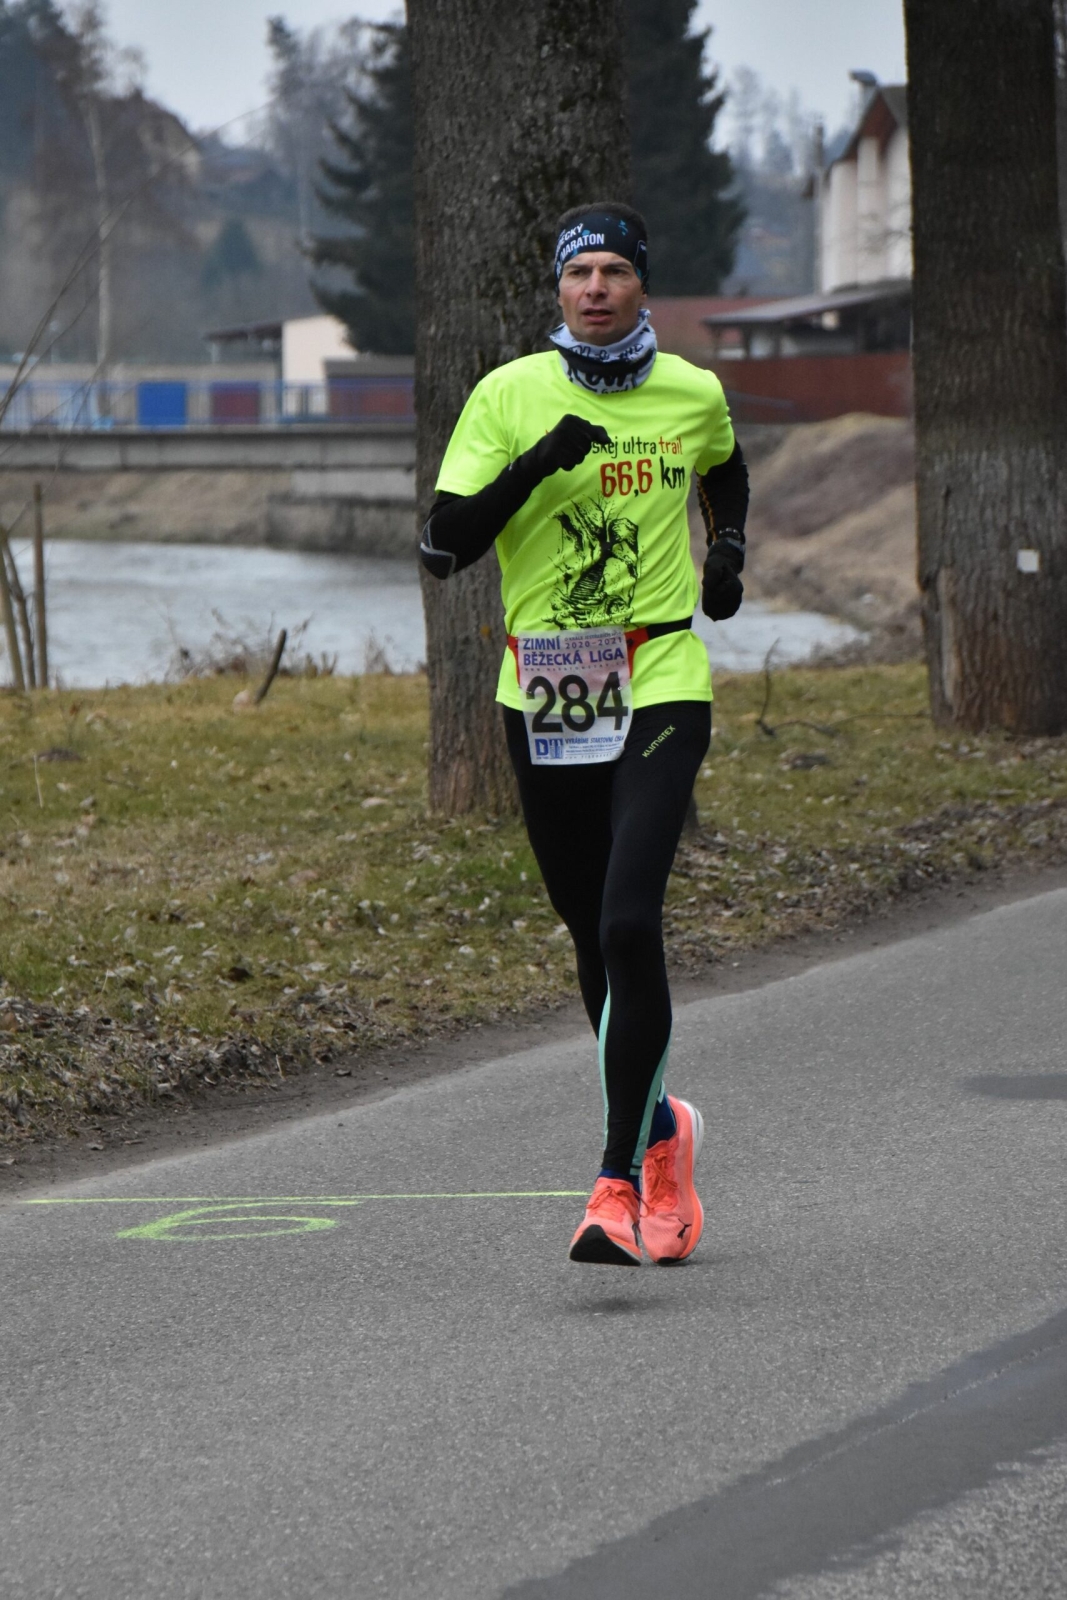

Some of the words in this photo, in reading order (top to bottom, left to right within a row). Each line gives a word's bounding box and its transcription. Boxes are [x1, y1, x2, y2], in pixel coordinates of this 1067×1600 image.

[560, 233, 605, 261] MARATON
[622, 436, 657, 455] ultra
[658, 436, 683, 455] trail
[600, 458, 653, 498] 66,6
[659, 456, 685, 490] km
[523, 636, 561, 650] ZIMNÍ
[523, 650, 583, 666] BĚŽECKÁ
[590, 647, 625, 663] LIGA
[526, 671, 628, 733] 284
